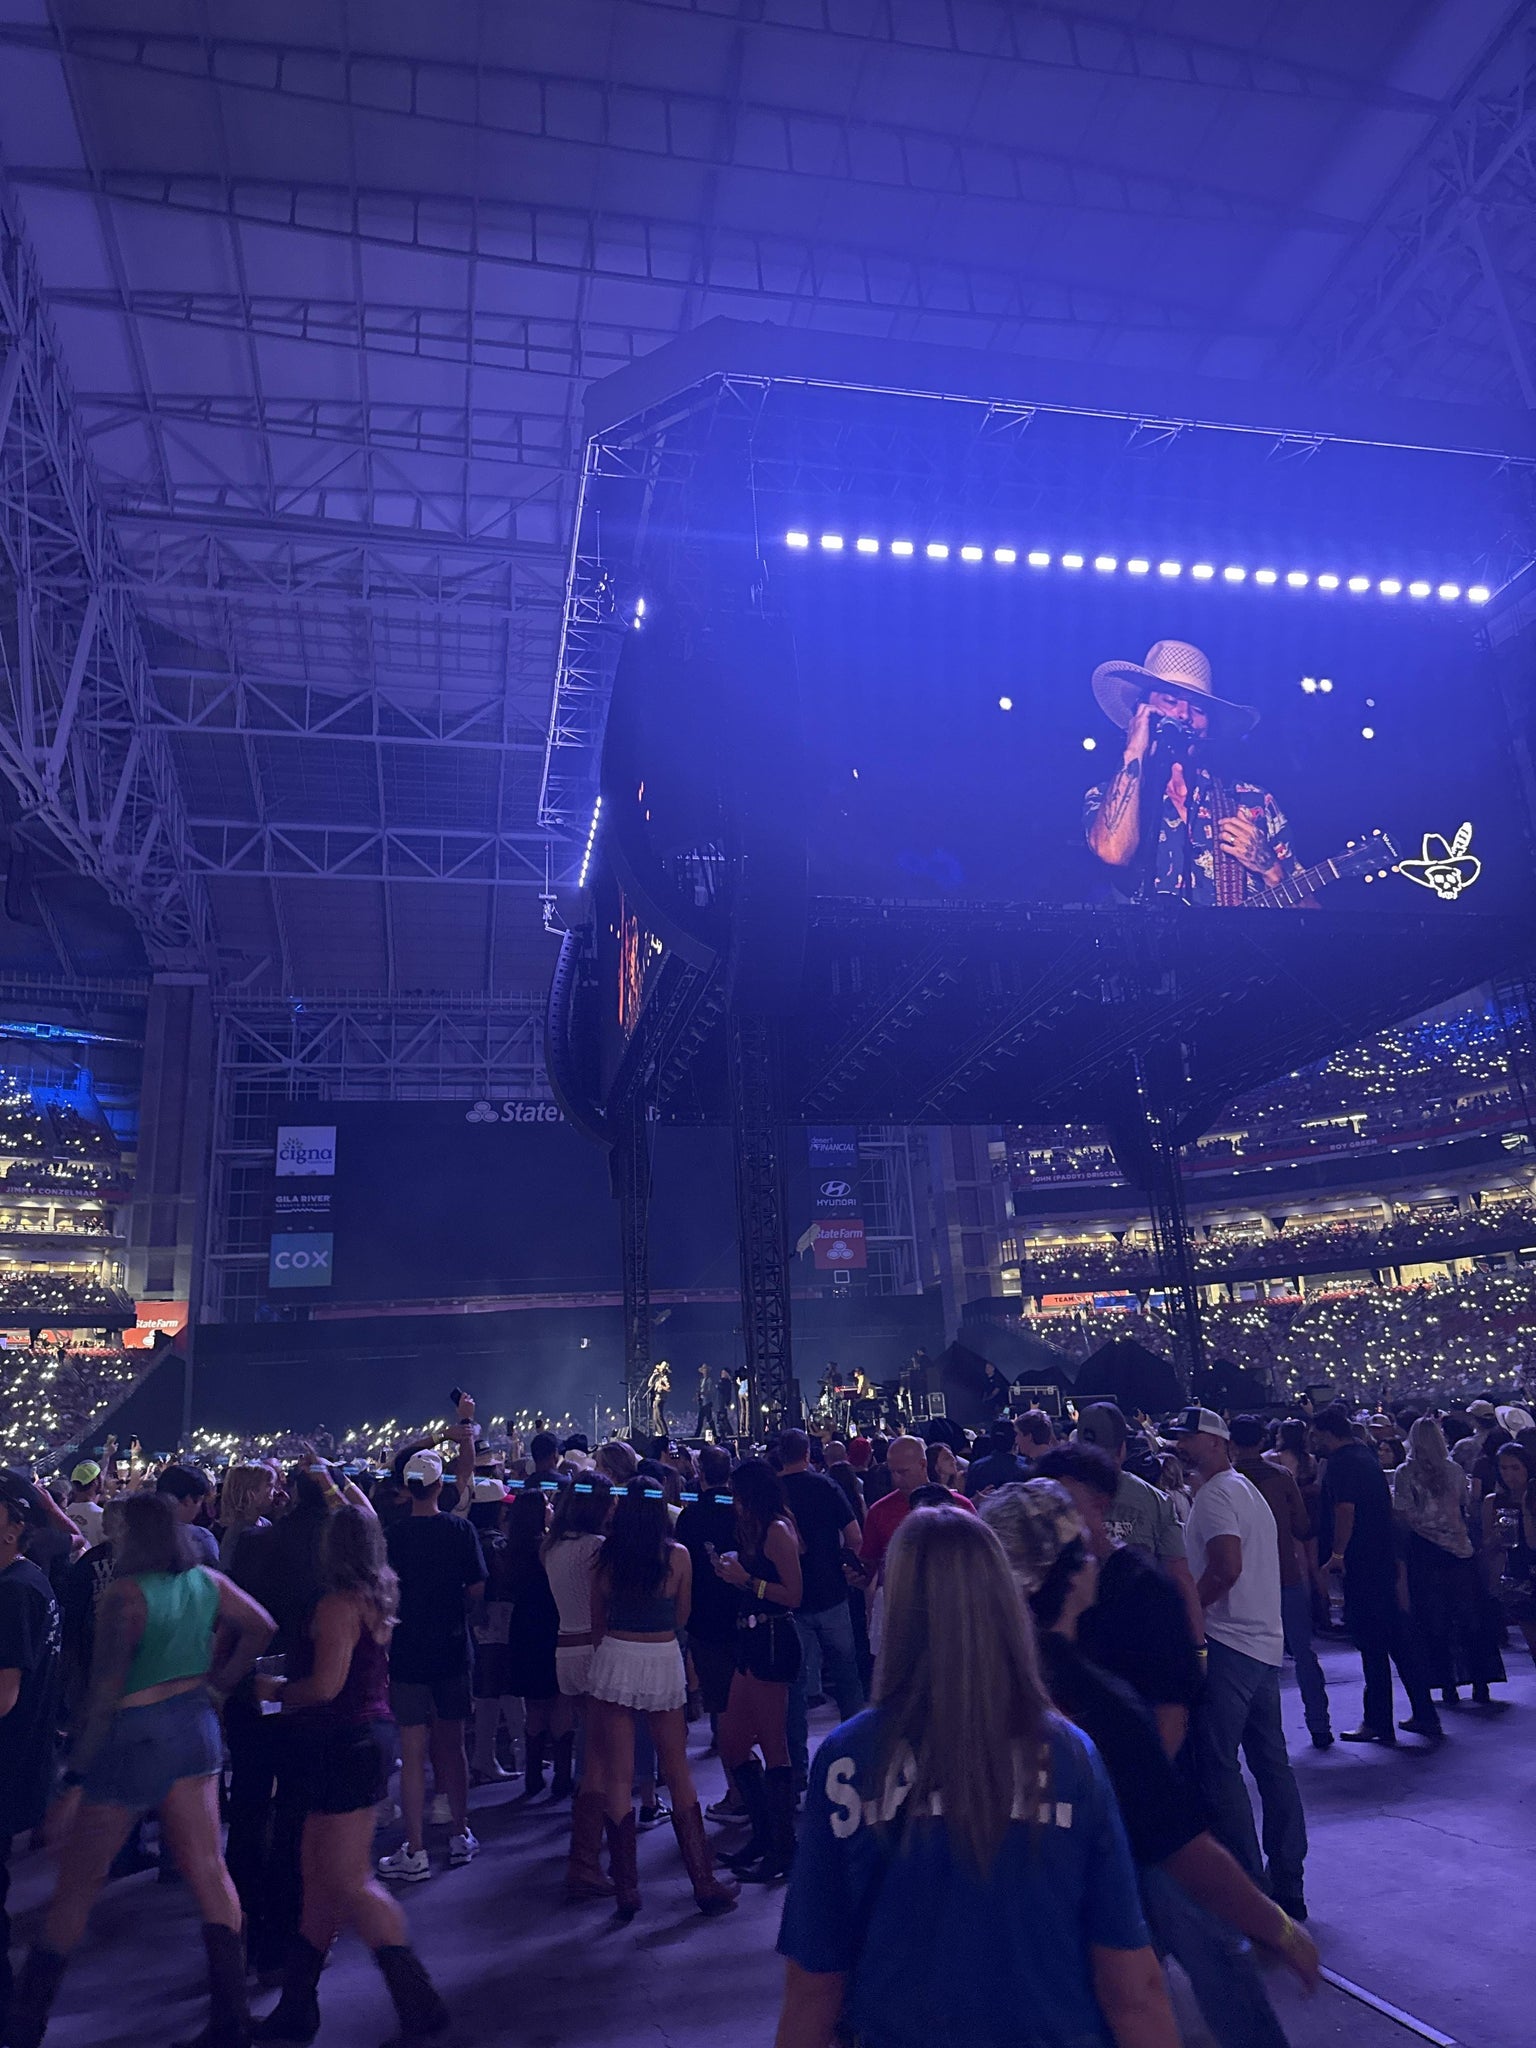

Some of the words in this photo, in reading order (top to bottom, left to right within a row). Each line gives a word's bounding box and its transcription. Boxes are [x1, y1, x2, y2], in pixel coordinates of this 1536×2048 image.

[279, 1145, 333, 1165] cigna
[1053, 1173, 1085, 1181] (PADDY)
[1086, 1170, 1123, 1178] DRISCOLL
[6, 1186, 36, 1194] JIMMY
[38, 1188, 97, 1197] CONZELMAN
[275, 1195, 299, 1203] GILA
[300, 1194, 330, 1202] RIVER
[275, 1250, 329, 1270] COX
